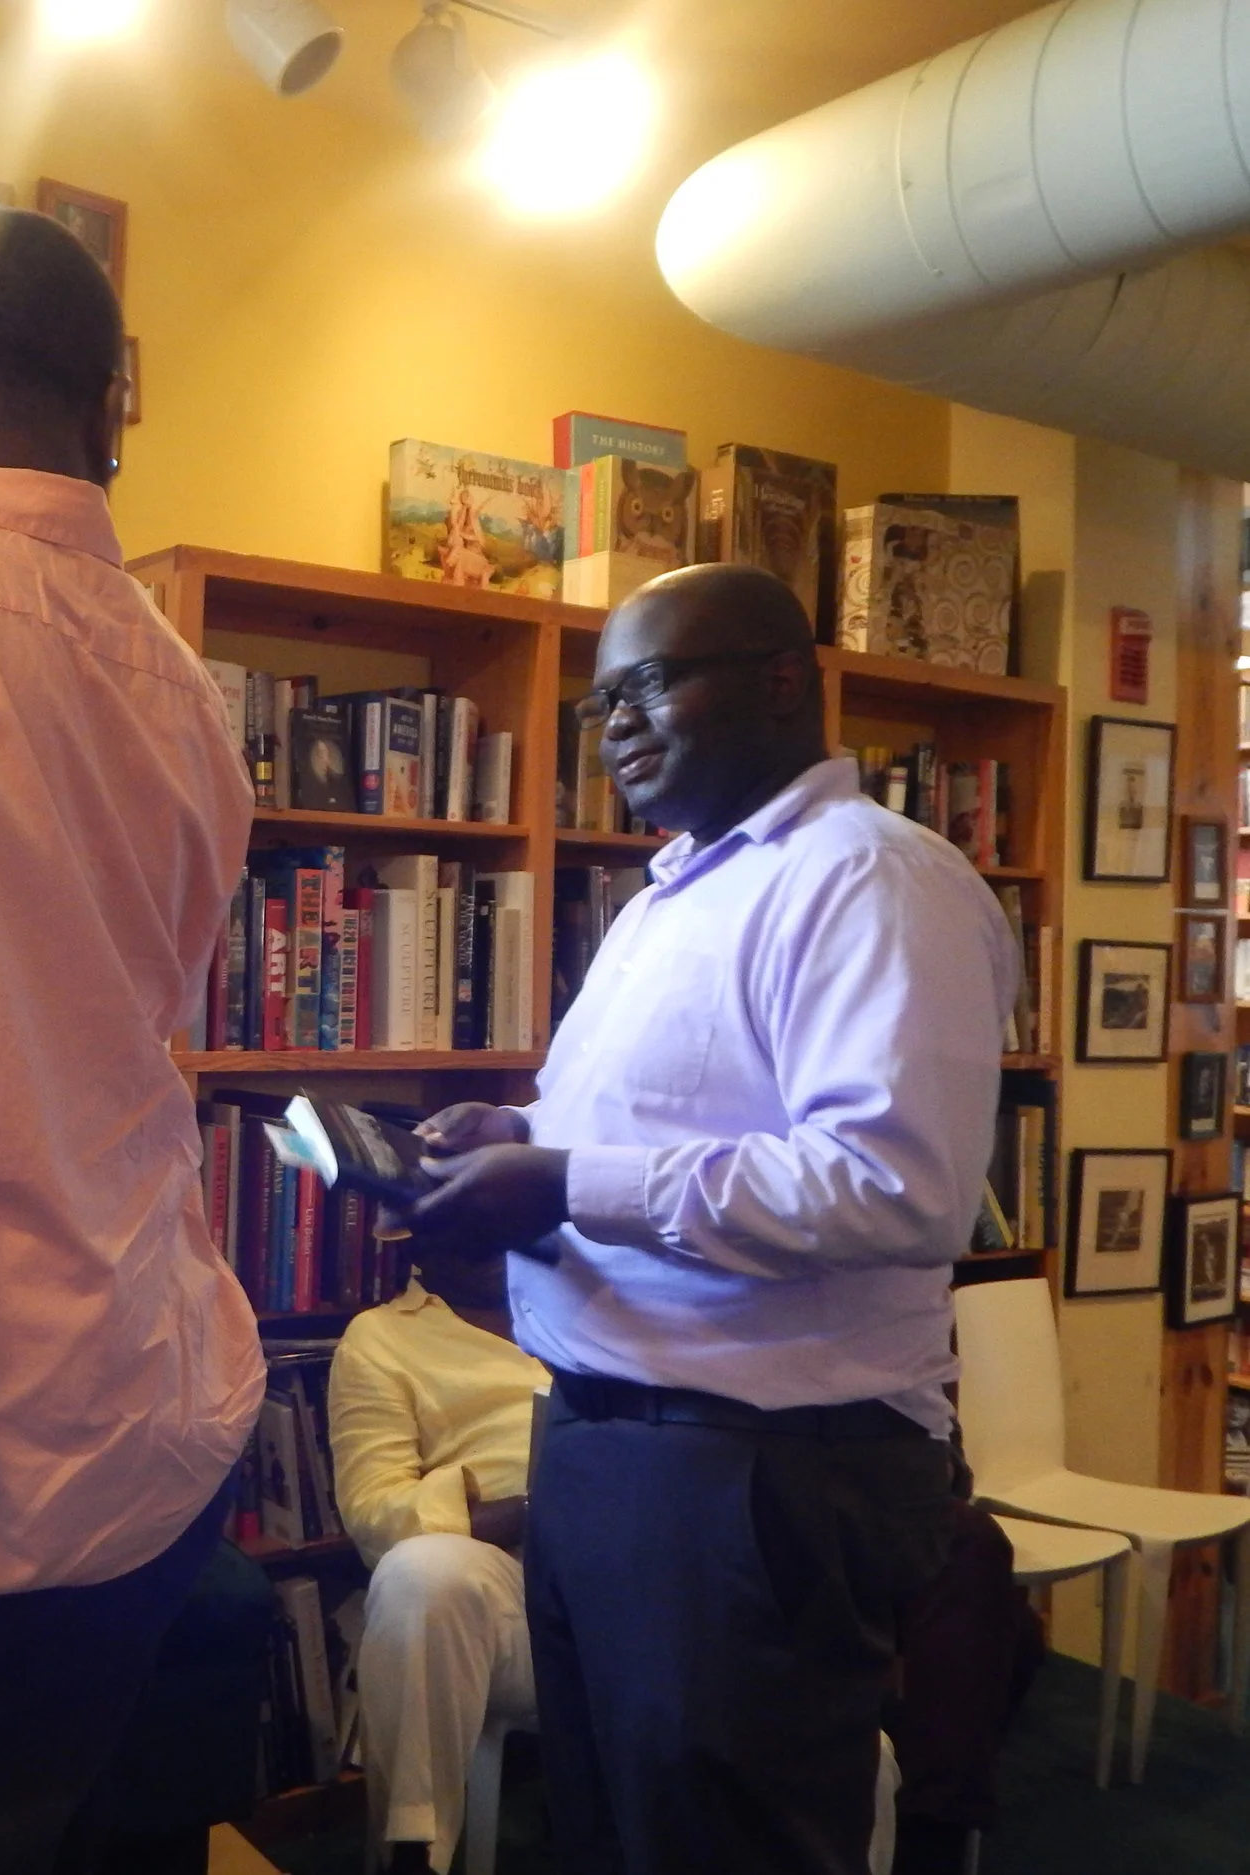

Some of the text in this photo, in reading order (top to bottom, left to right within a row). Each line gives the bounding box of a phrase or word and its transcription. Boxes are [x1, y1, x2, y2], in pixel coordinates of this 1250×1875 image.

[592, 434, 666, 456] THE HISTORY
[301, 875, 321, 925] THE
[268, 927, 287, 998] ART
[298, 928, 321, 993] ART
[400, 923, 412, 1015] SCULPTURE
[423, 889, 436, 1013] SCULPTURE
